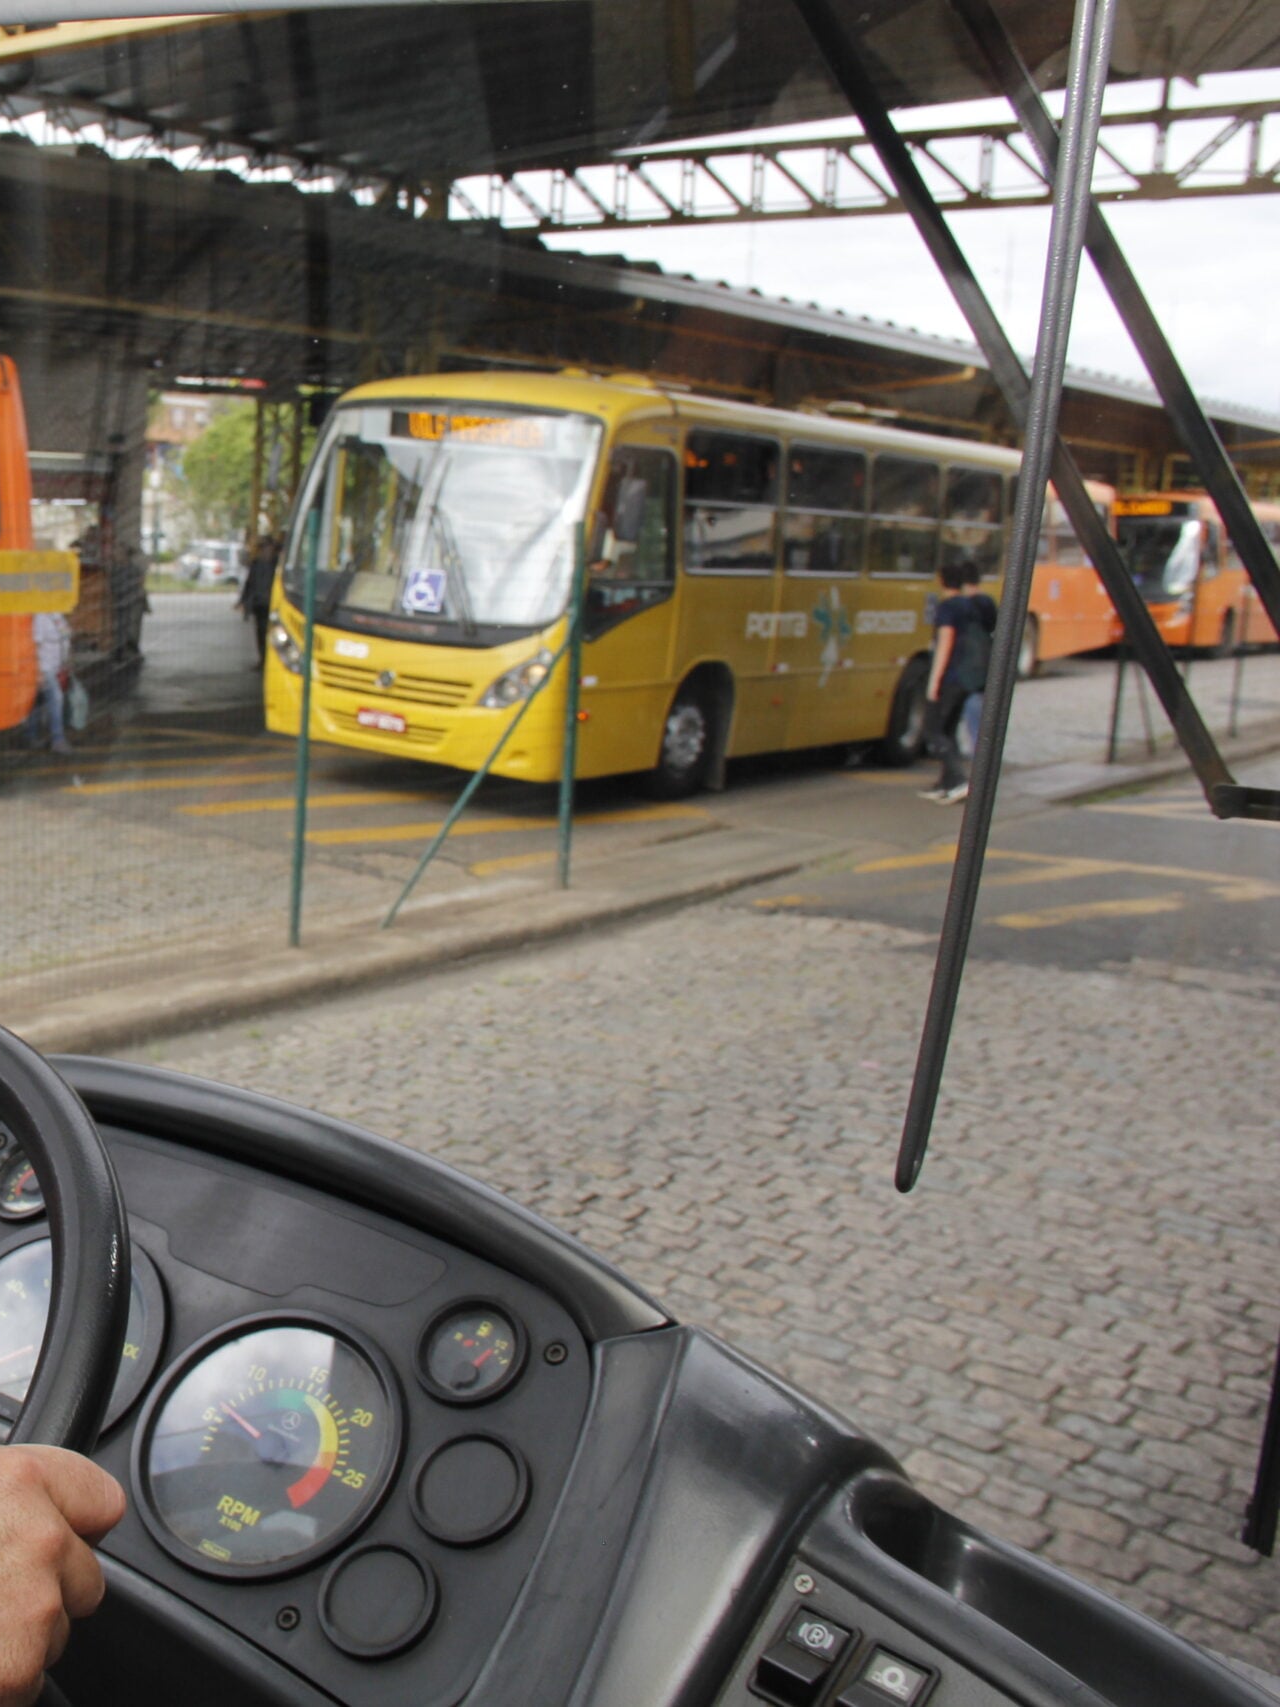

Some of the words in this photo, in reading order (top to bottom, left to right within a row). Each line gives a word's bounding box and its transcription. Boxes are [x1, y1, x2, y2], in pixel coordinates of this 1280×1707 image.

[247, 1364, 267, 1382] 10
[308, 1365, 329, 1384] 15
[201, 1406, 216, 1422] 5
[349, 1408, 374, 1428] 20
[340, 1468, 367, 1489] 25
[216, 1494, 261, 1527] RPM
